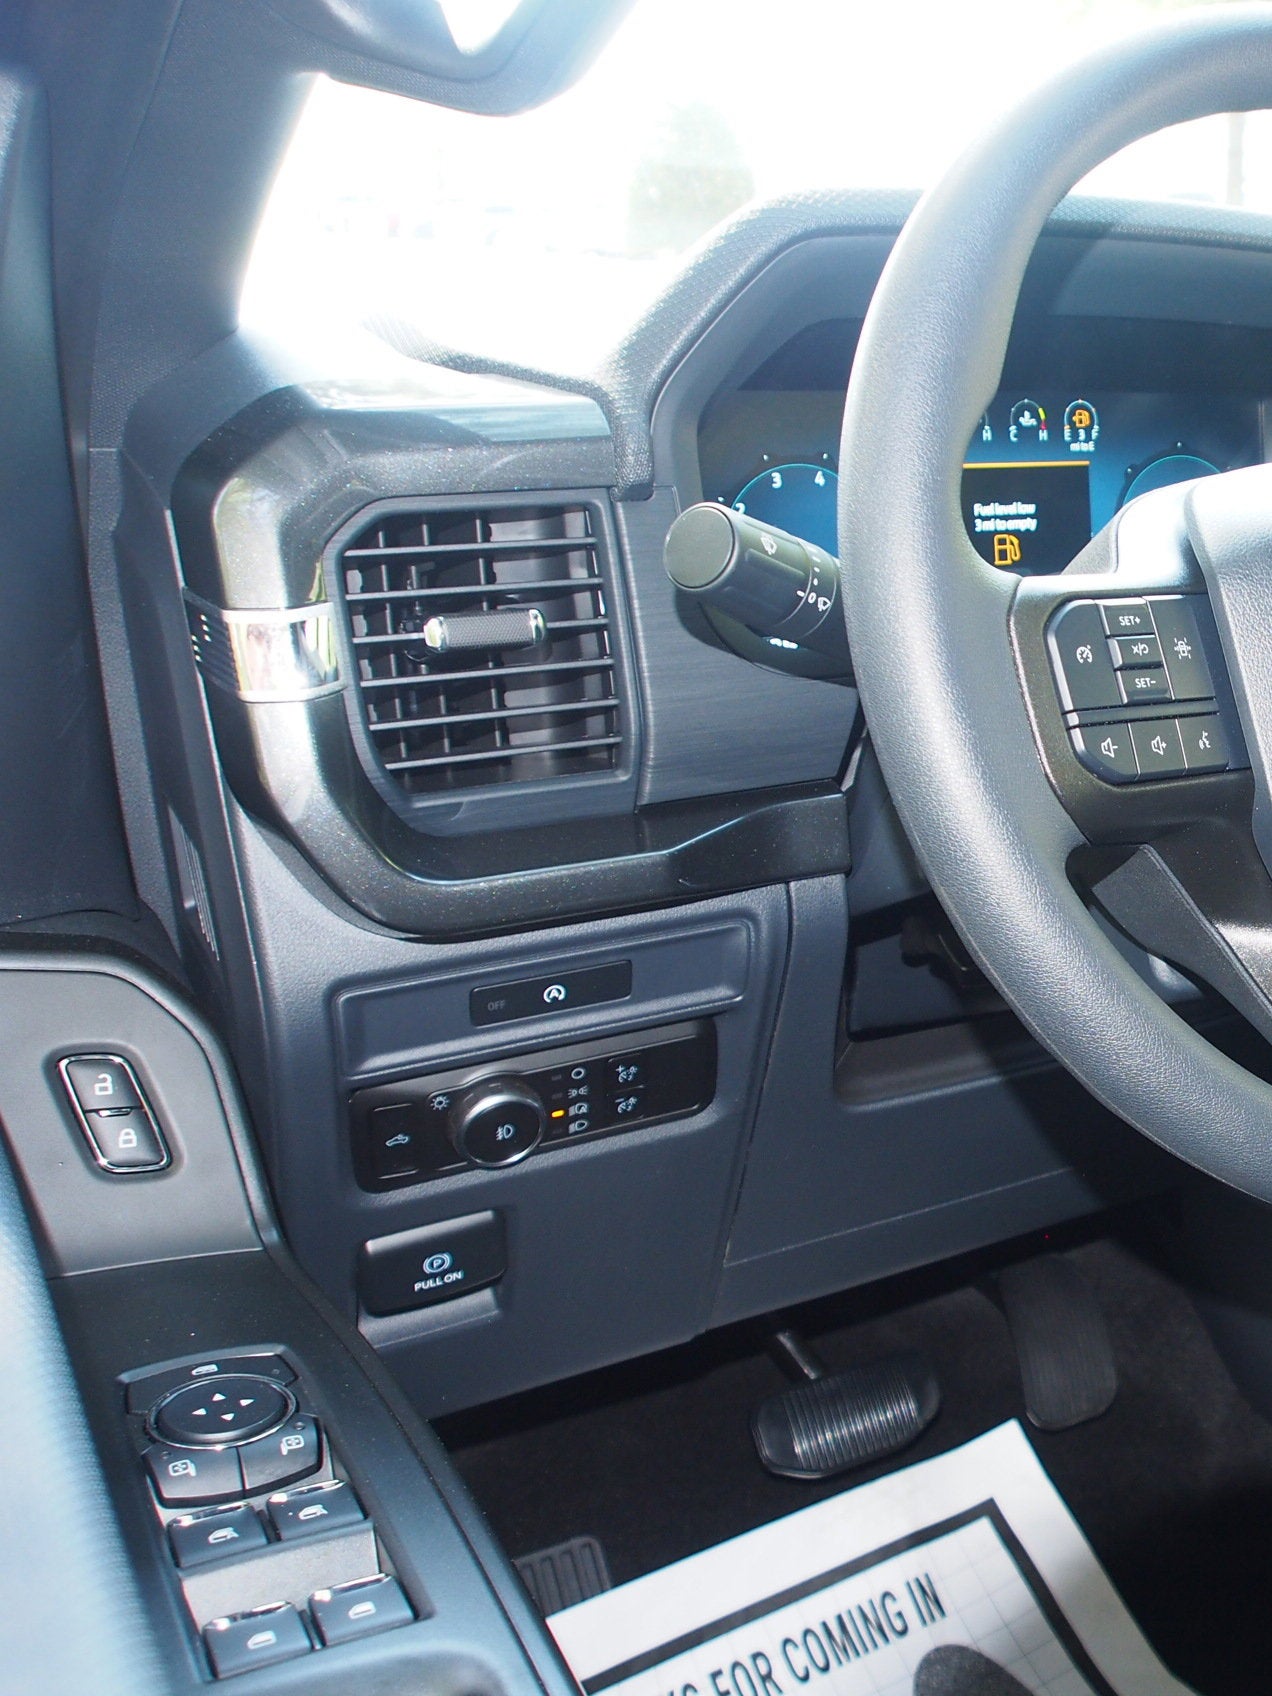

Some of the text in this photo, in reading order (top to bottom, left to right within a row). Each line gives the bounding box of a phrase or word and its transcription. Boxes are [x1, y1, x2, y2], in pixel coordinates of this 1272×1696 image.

[982, 429, 992, 441] H
[1009, 429, 1018, 442] C
[1038, 429, 1048, 441] H
[1064, 428, 1099, 441] E 3 F
[771, 472, 782, 489] 3
[814, 470, 825, 487] 4
[973, 501, 1036, 517] Fuel level low
[974, 518, 982, 532] 3
[1007, 517, 1037, 532] empty
[487, 1000, 506, 1012] OFF
[414, 1270, 464, 1292] PULL ON
[780, 1590, 909, 1684] COMING
[906, 1573, 947, 1627] IN
